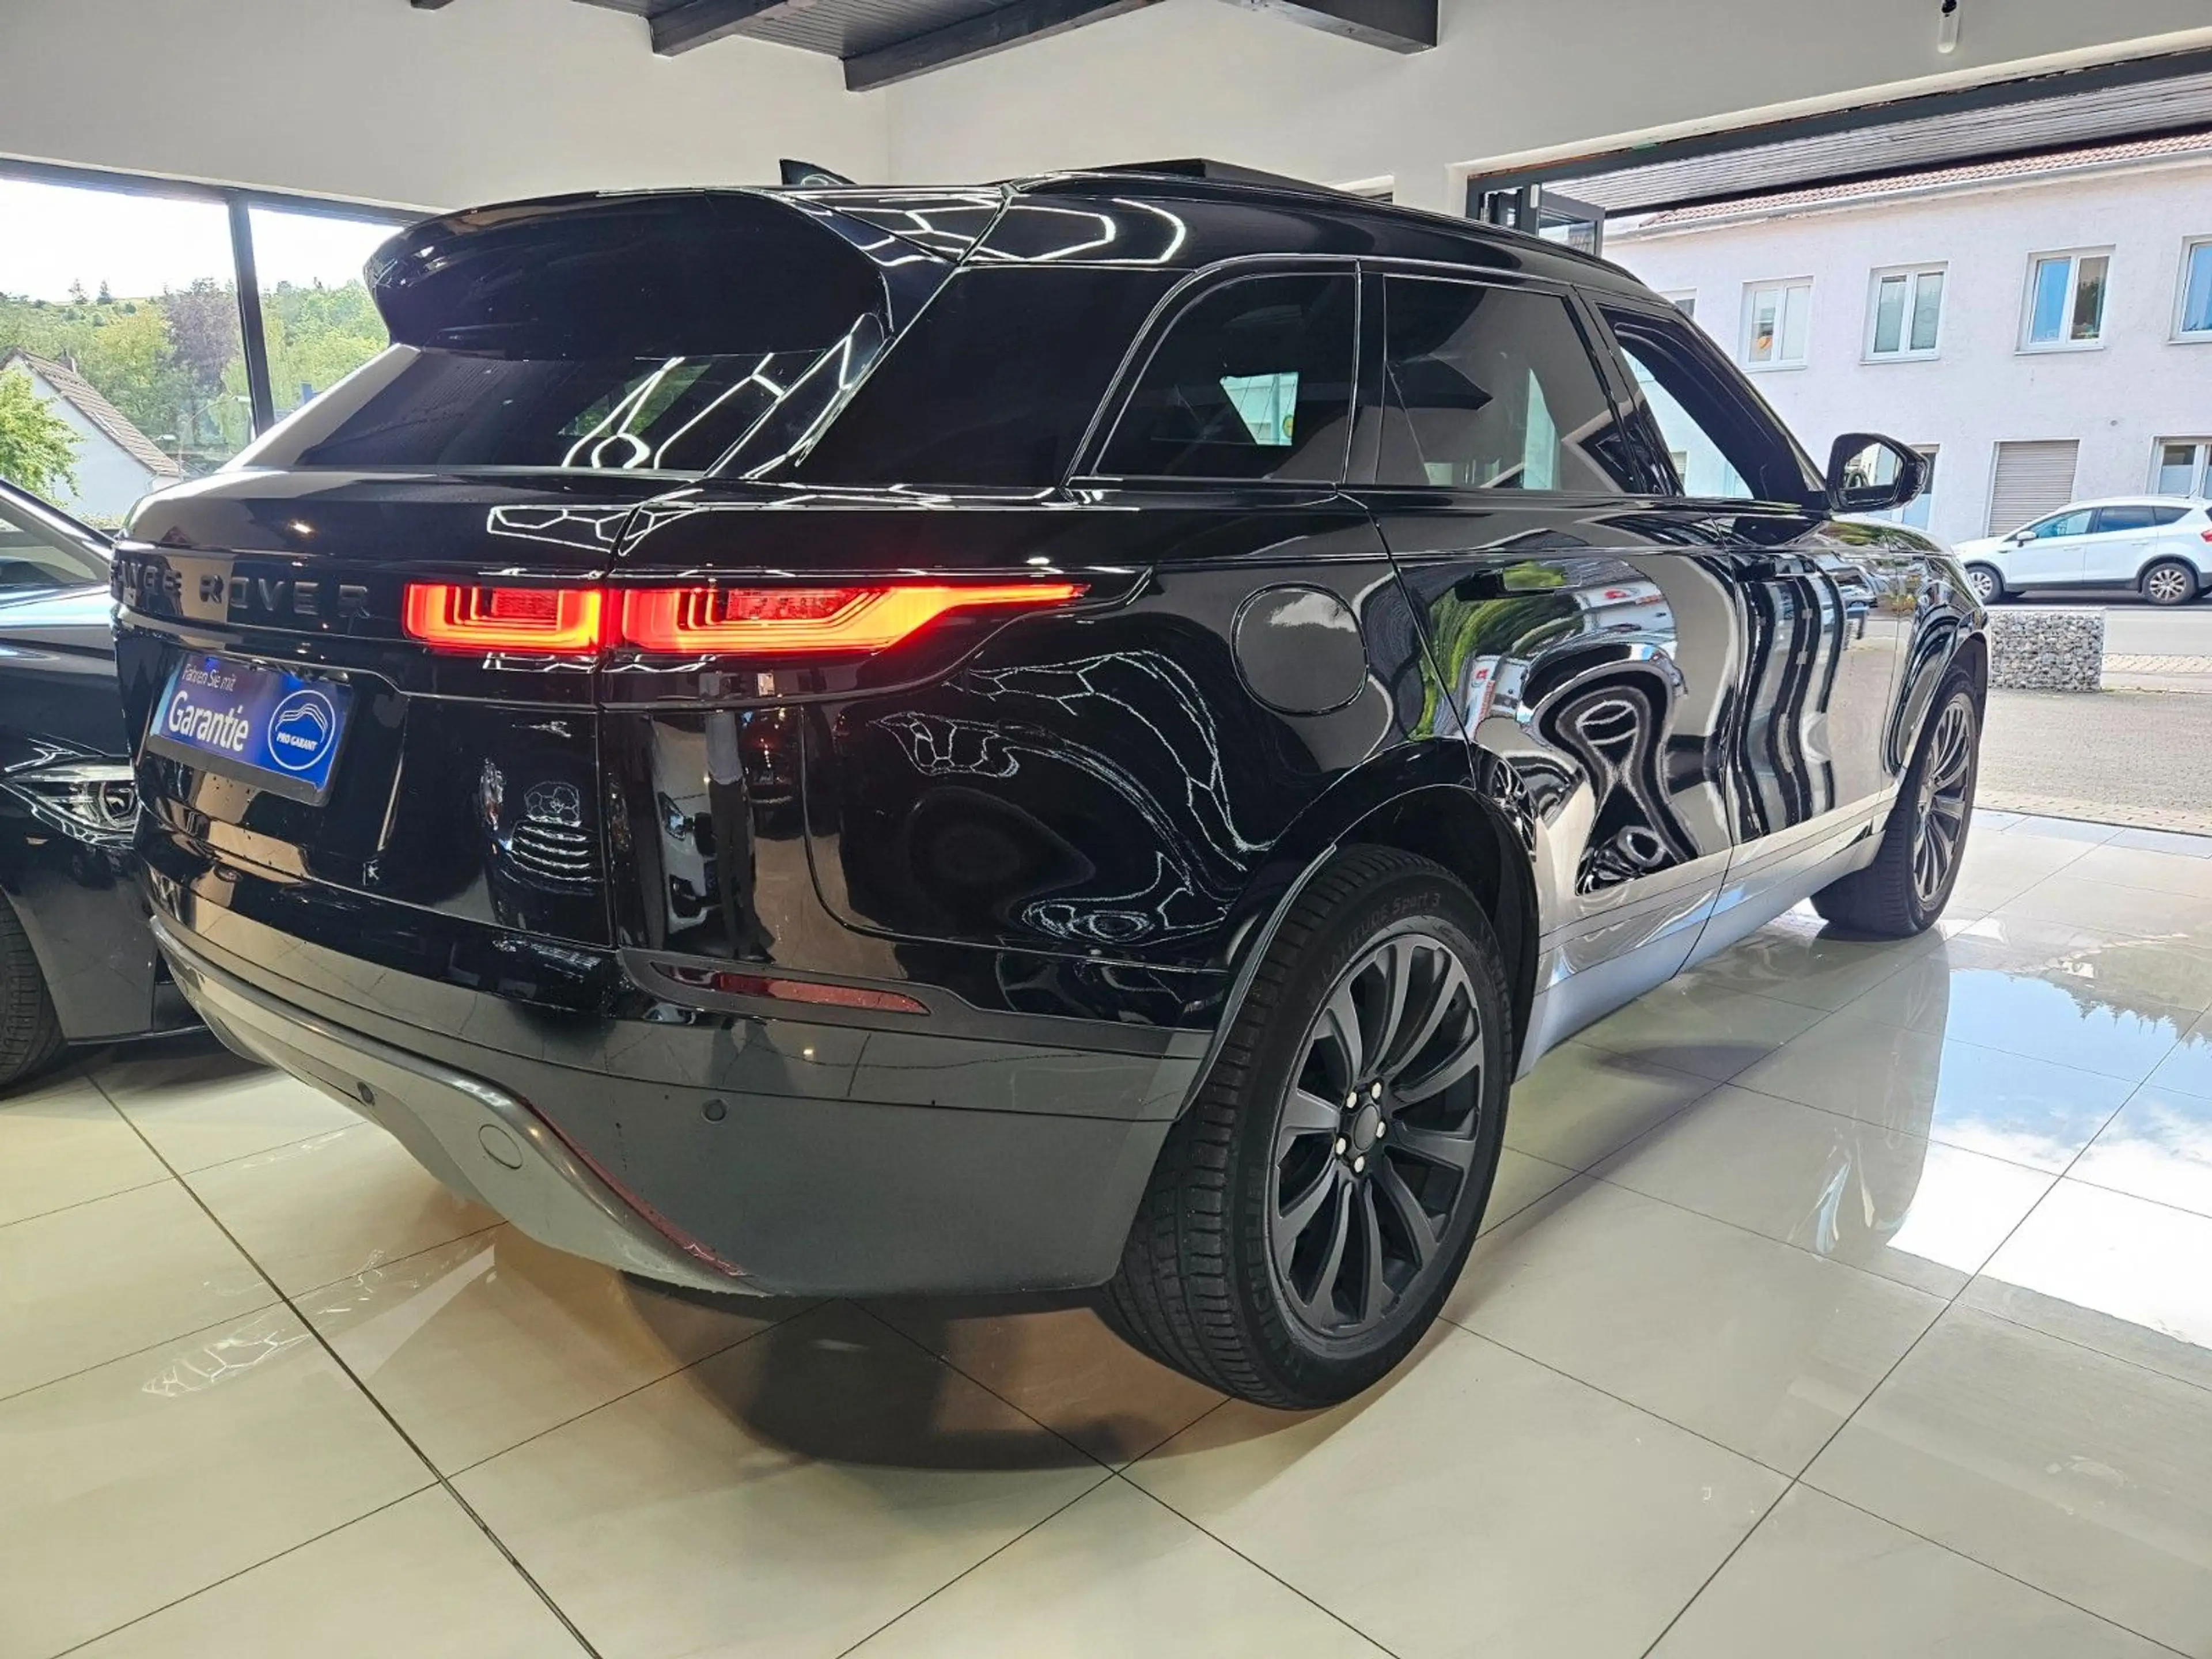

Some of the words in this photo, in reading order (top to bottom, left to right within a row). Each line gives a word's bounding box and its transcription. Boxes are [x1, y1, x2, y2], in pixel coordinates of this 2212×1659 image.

[199, 574, 371, 619] ROVER
[182, 664, 208, 685] Fahren
[207, 669, 221, 688] Sie
[219, 673, 237, 692] mit
[168, 691, 249, 751] Garantie
[276, 731, 291, 744] PRO
